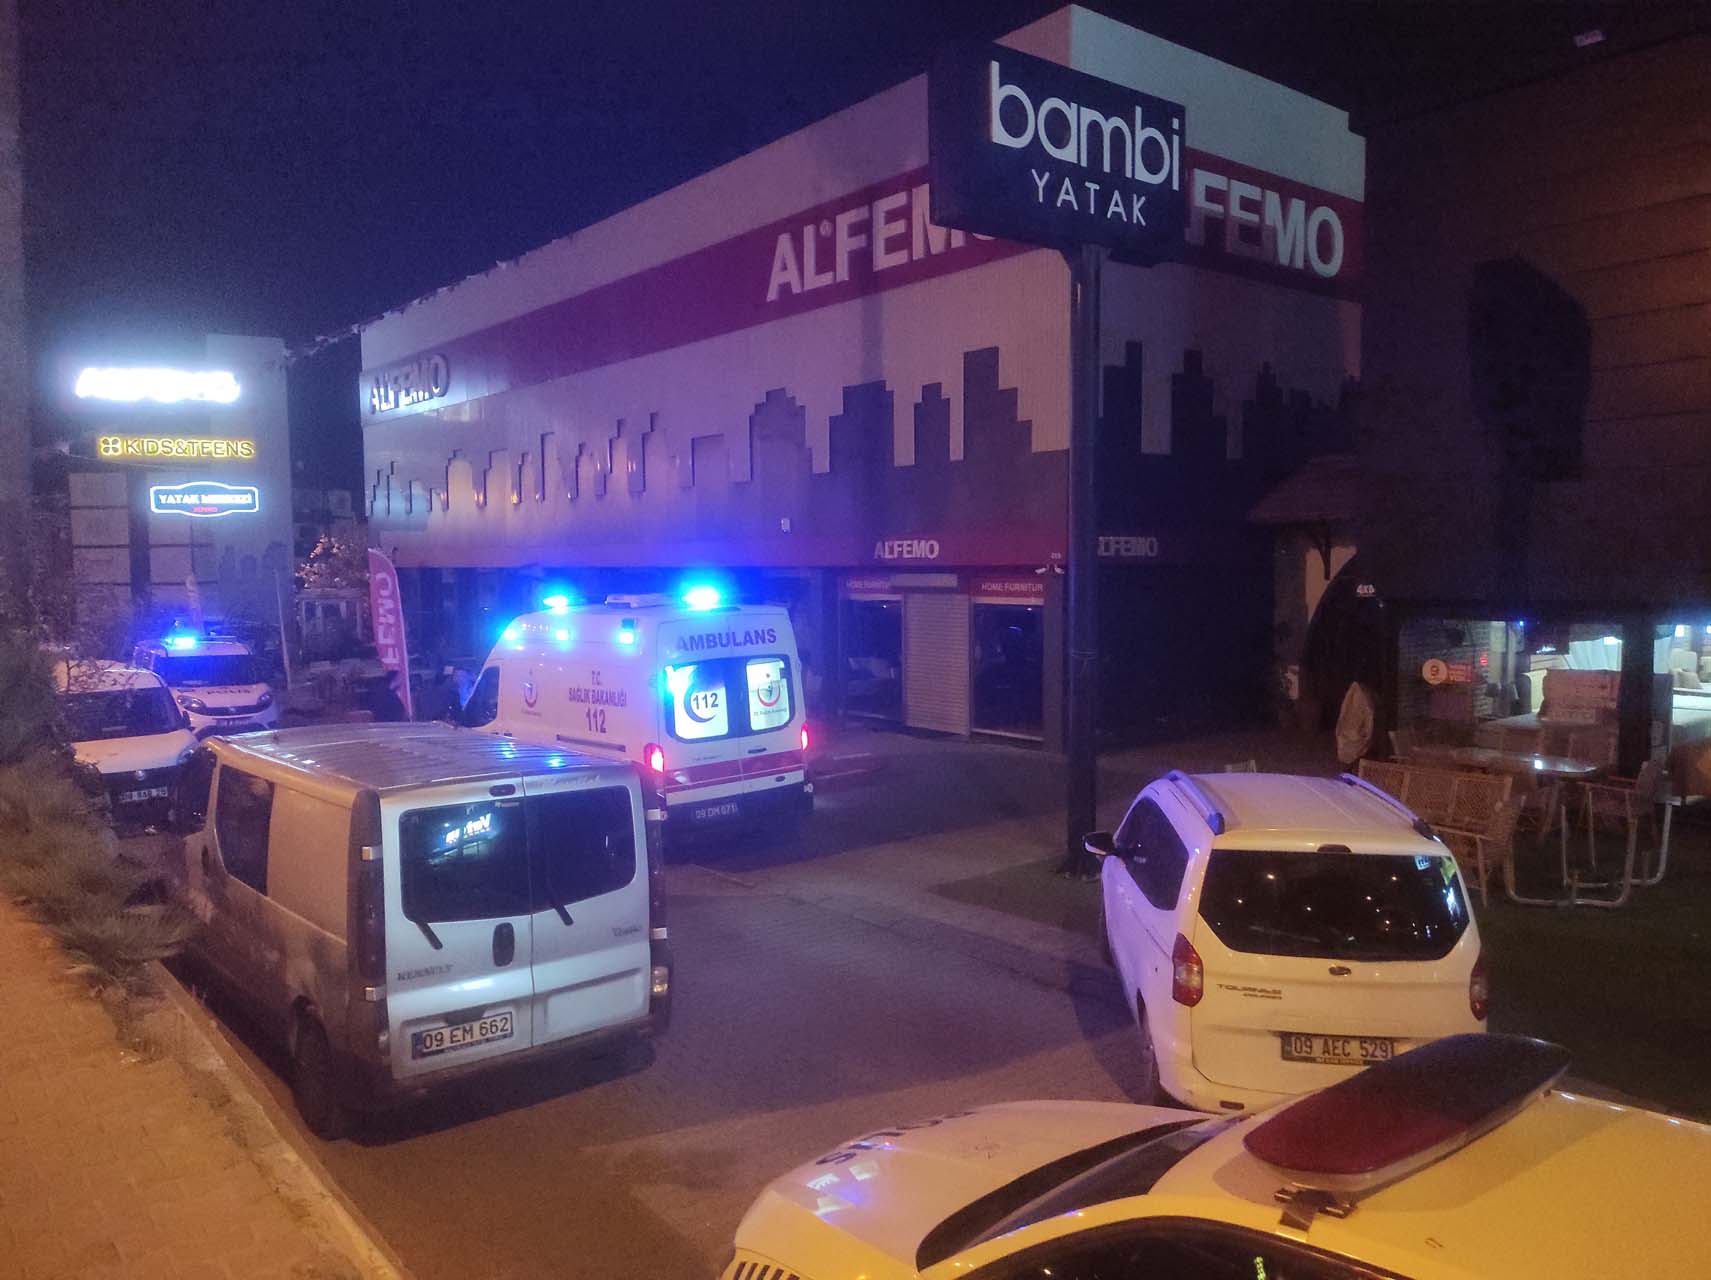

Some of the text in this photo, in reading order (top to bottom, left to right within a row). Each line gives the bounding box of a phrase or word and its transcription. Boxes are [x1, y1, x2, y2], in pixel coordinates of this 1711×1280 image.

[991, 60, 1180, 191] bambi
[1031, 168, 1146, 226] YATAK
[1190, 168, 1345, 278] FEMO
[766, 183, 996, 302] ALFEM
[873, 539, 940, 560] ALFEMO
[676, 628, 777, 651] AMBULANS
[693, 692, 719, 710] 112
[585, 707, 607, 733] 112
[423, 1016, 509, 1050] 09 EM 662
[1294, 1037, 1389, 1059] 09 AEC 529
